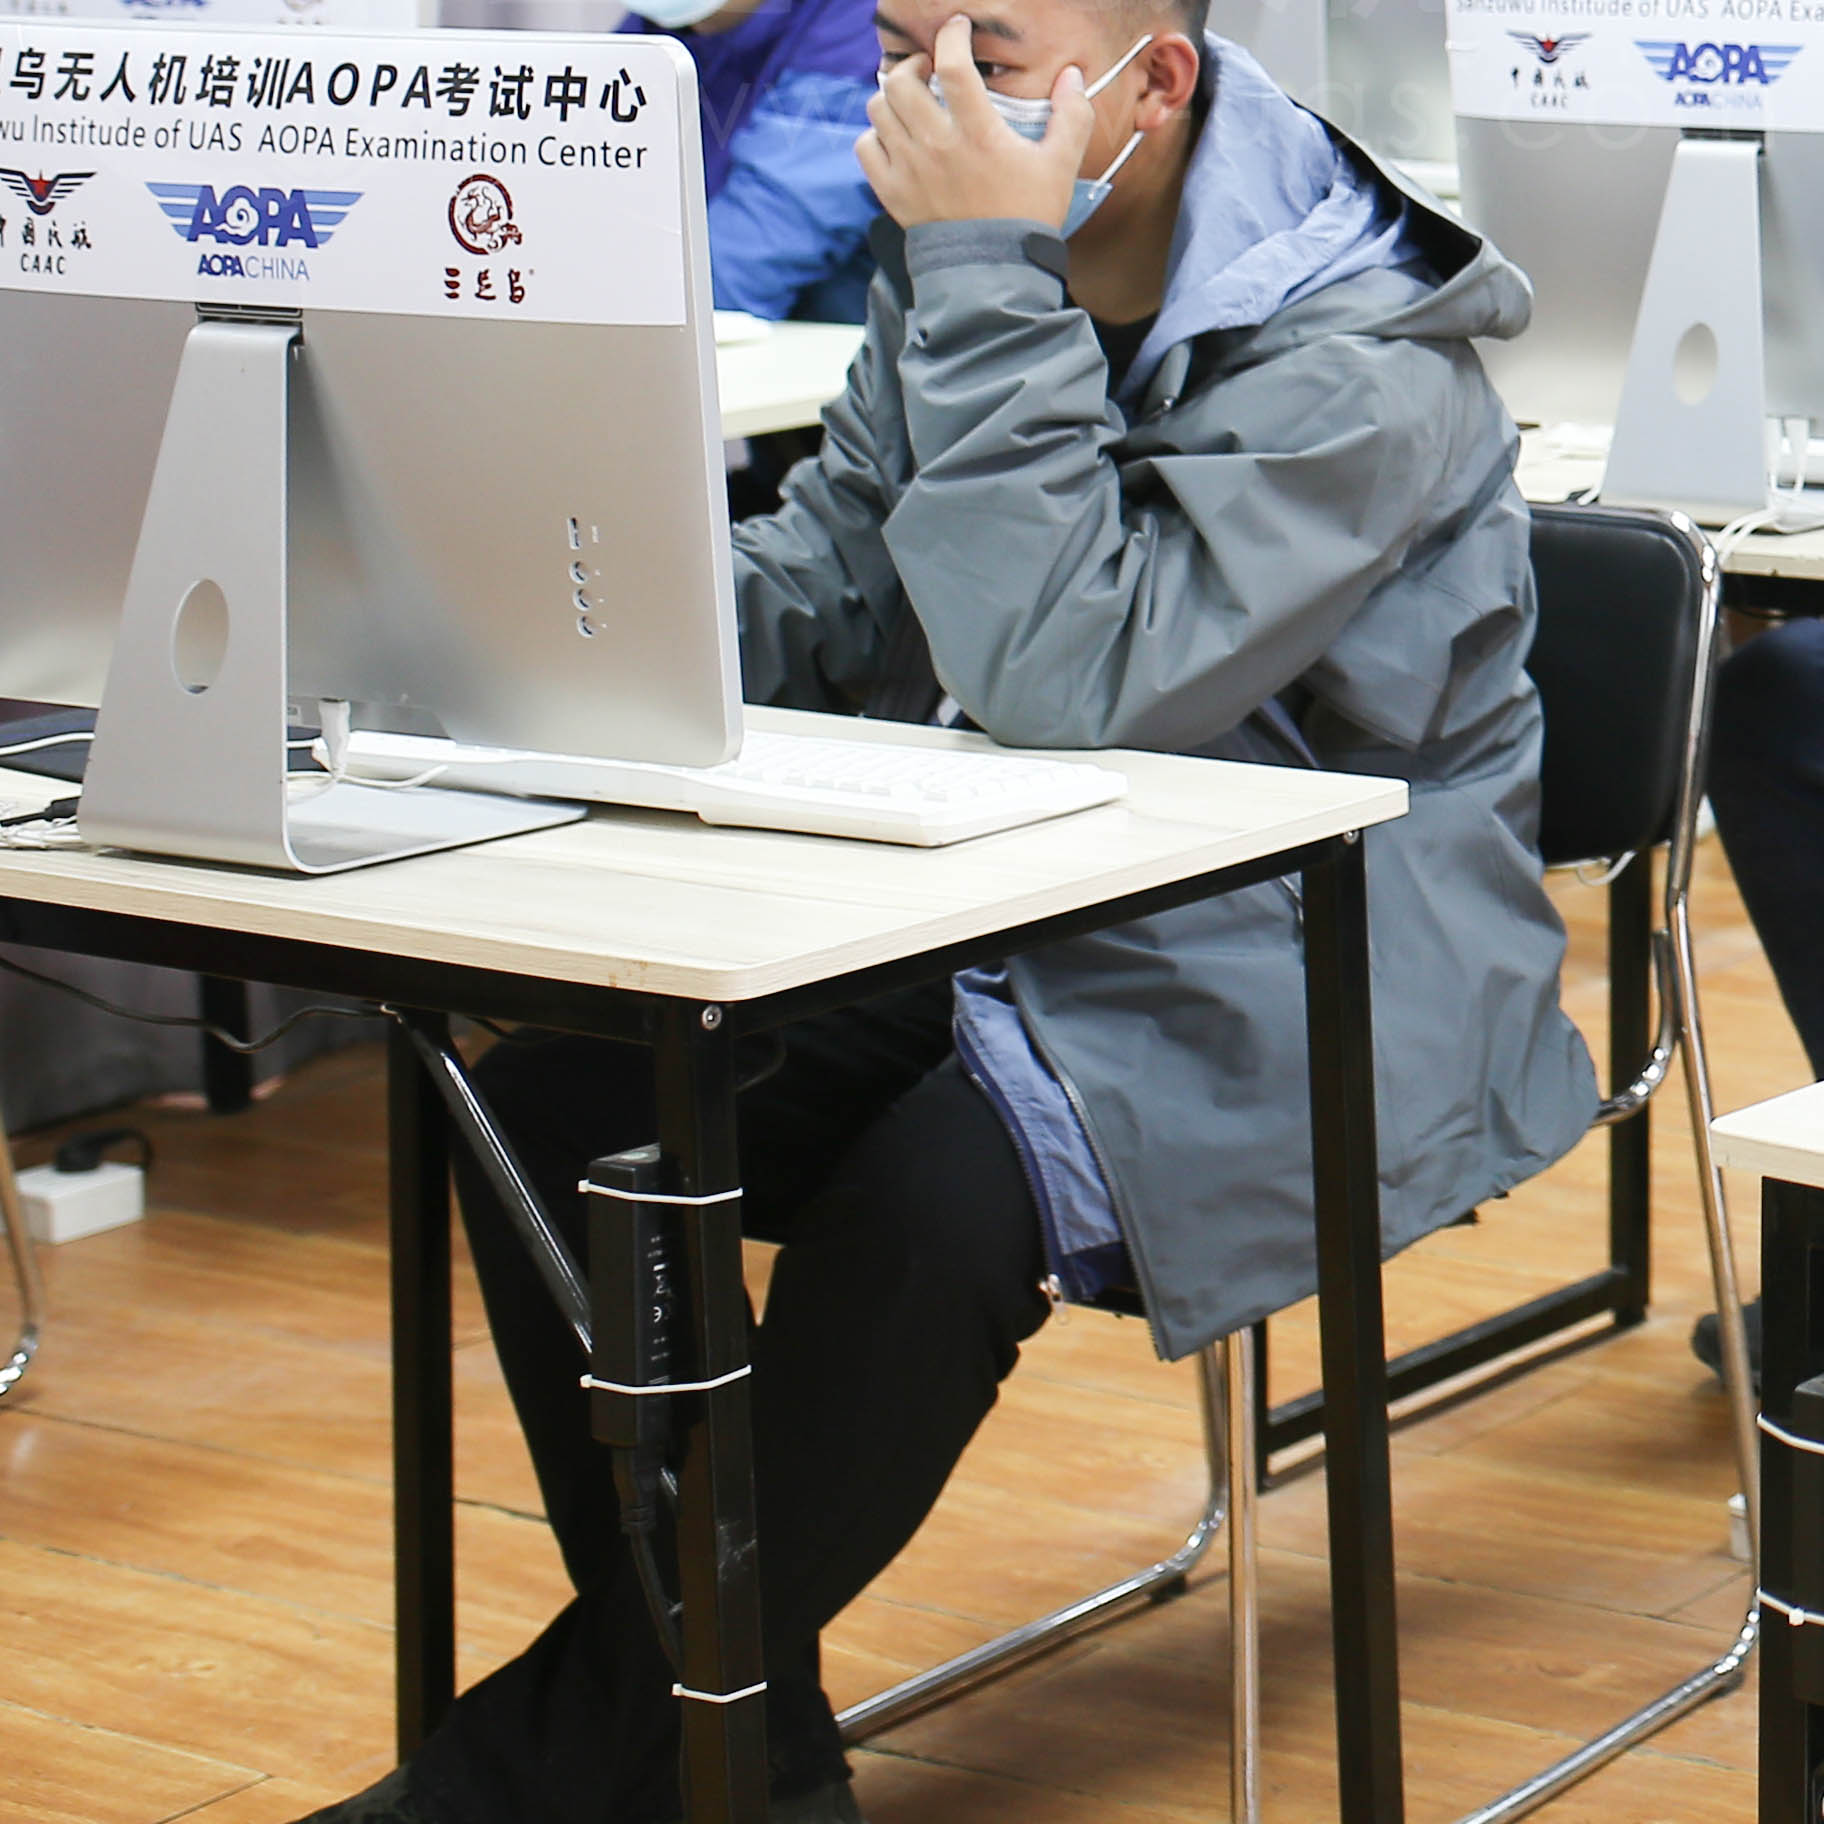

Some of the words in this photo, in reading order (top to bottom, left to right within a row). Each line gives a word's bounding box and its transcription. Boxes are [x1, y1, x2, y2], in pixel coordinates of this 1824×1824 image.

[0, 47, 648, 124] 乌无人机培训AOPA考试中心
[1666, 42, 1770, 85] AOPA
[33, 114, 147, 149] Institude
[154, 117, 182, 149] of
[189, 121, 244, 153] UAS
[258, 123, 336, 157] AOPA
[345, 127, 528, 166] Examination
[538, 135, 648, 170] Center
[186, 184, 320, 250] AOPA
[20, 253, 67, 276] CAAC
